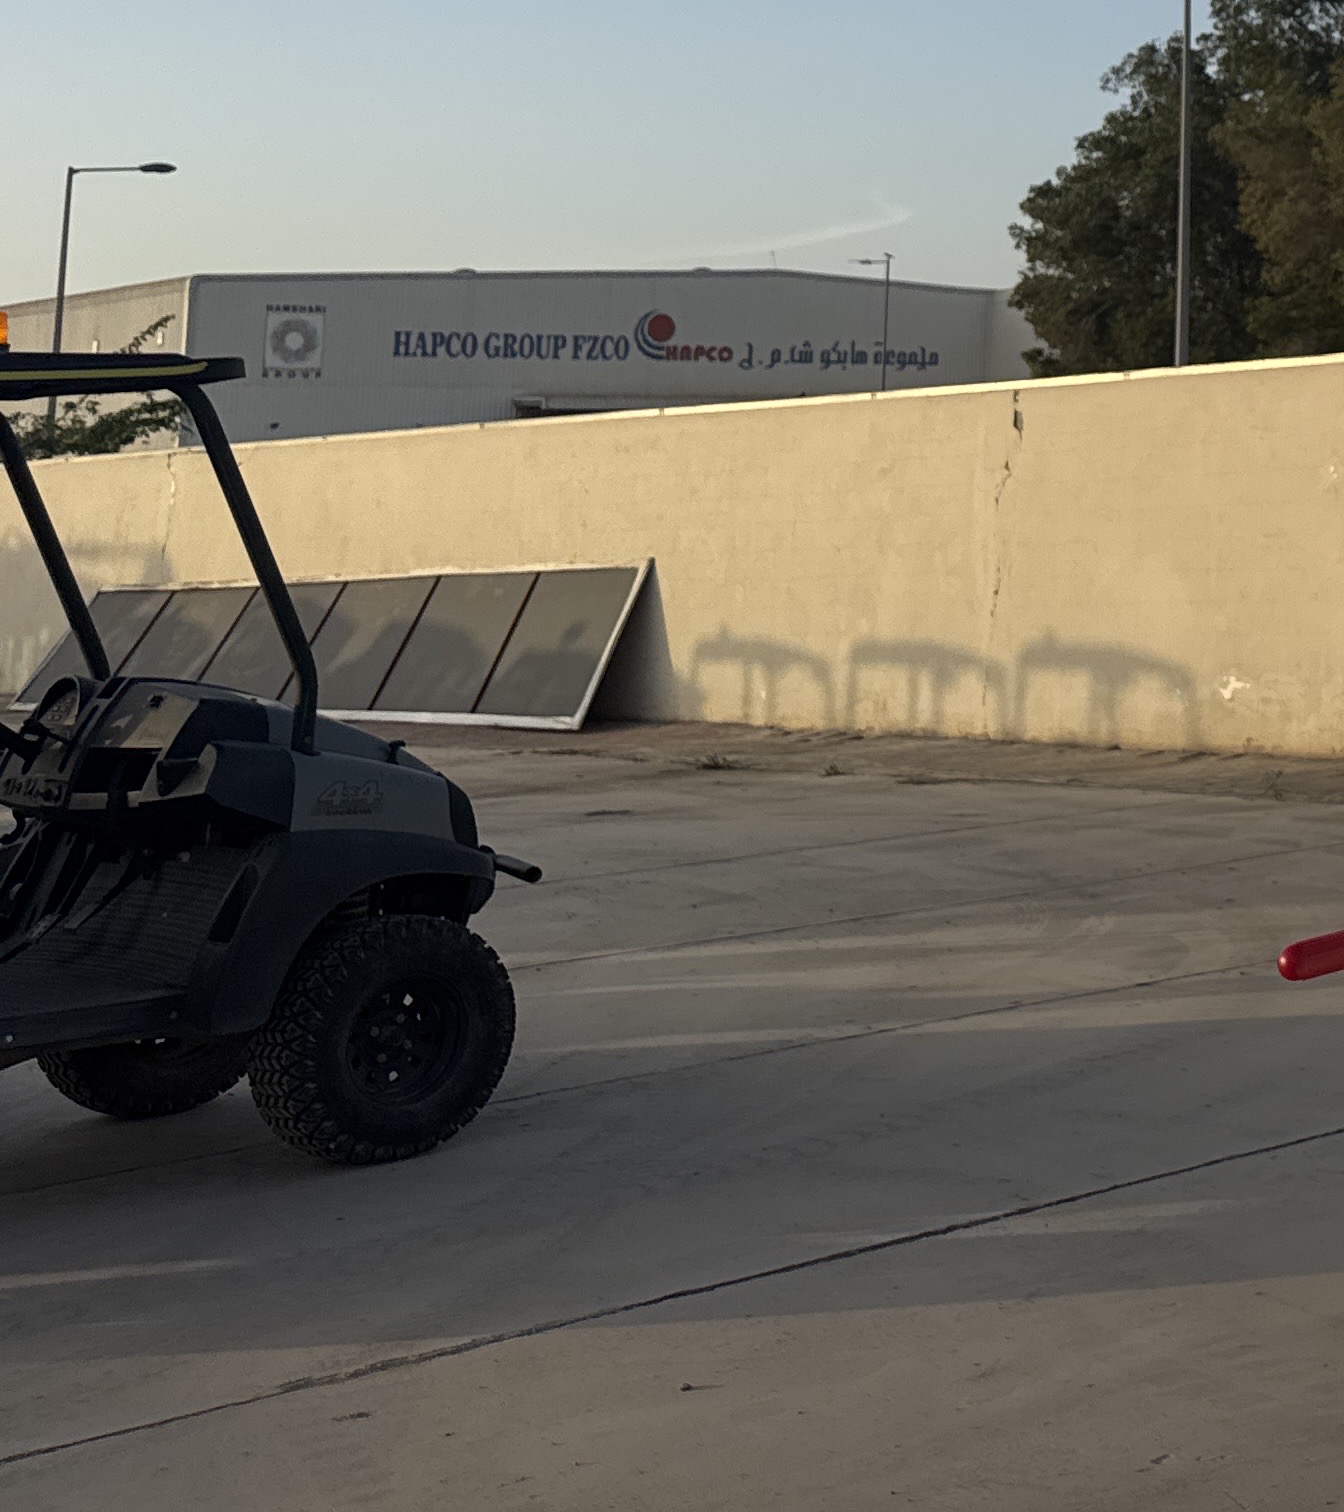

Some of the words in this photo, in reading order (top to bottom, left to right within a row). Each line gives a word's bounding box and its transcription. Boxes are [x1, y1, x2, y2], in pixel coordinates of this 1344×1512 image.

[392, 329, 479, 359] HAPCO
[483, 331, 568, 361] GROUP
[571, 334, 631, 362] FZCO
[664, 343, 735, 363] HAPCO
